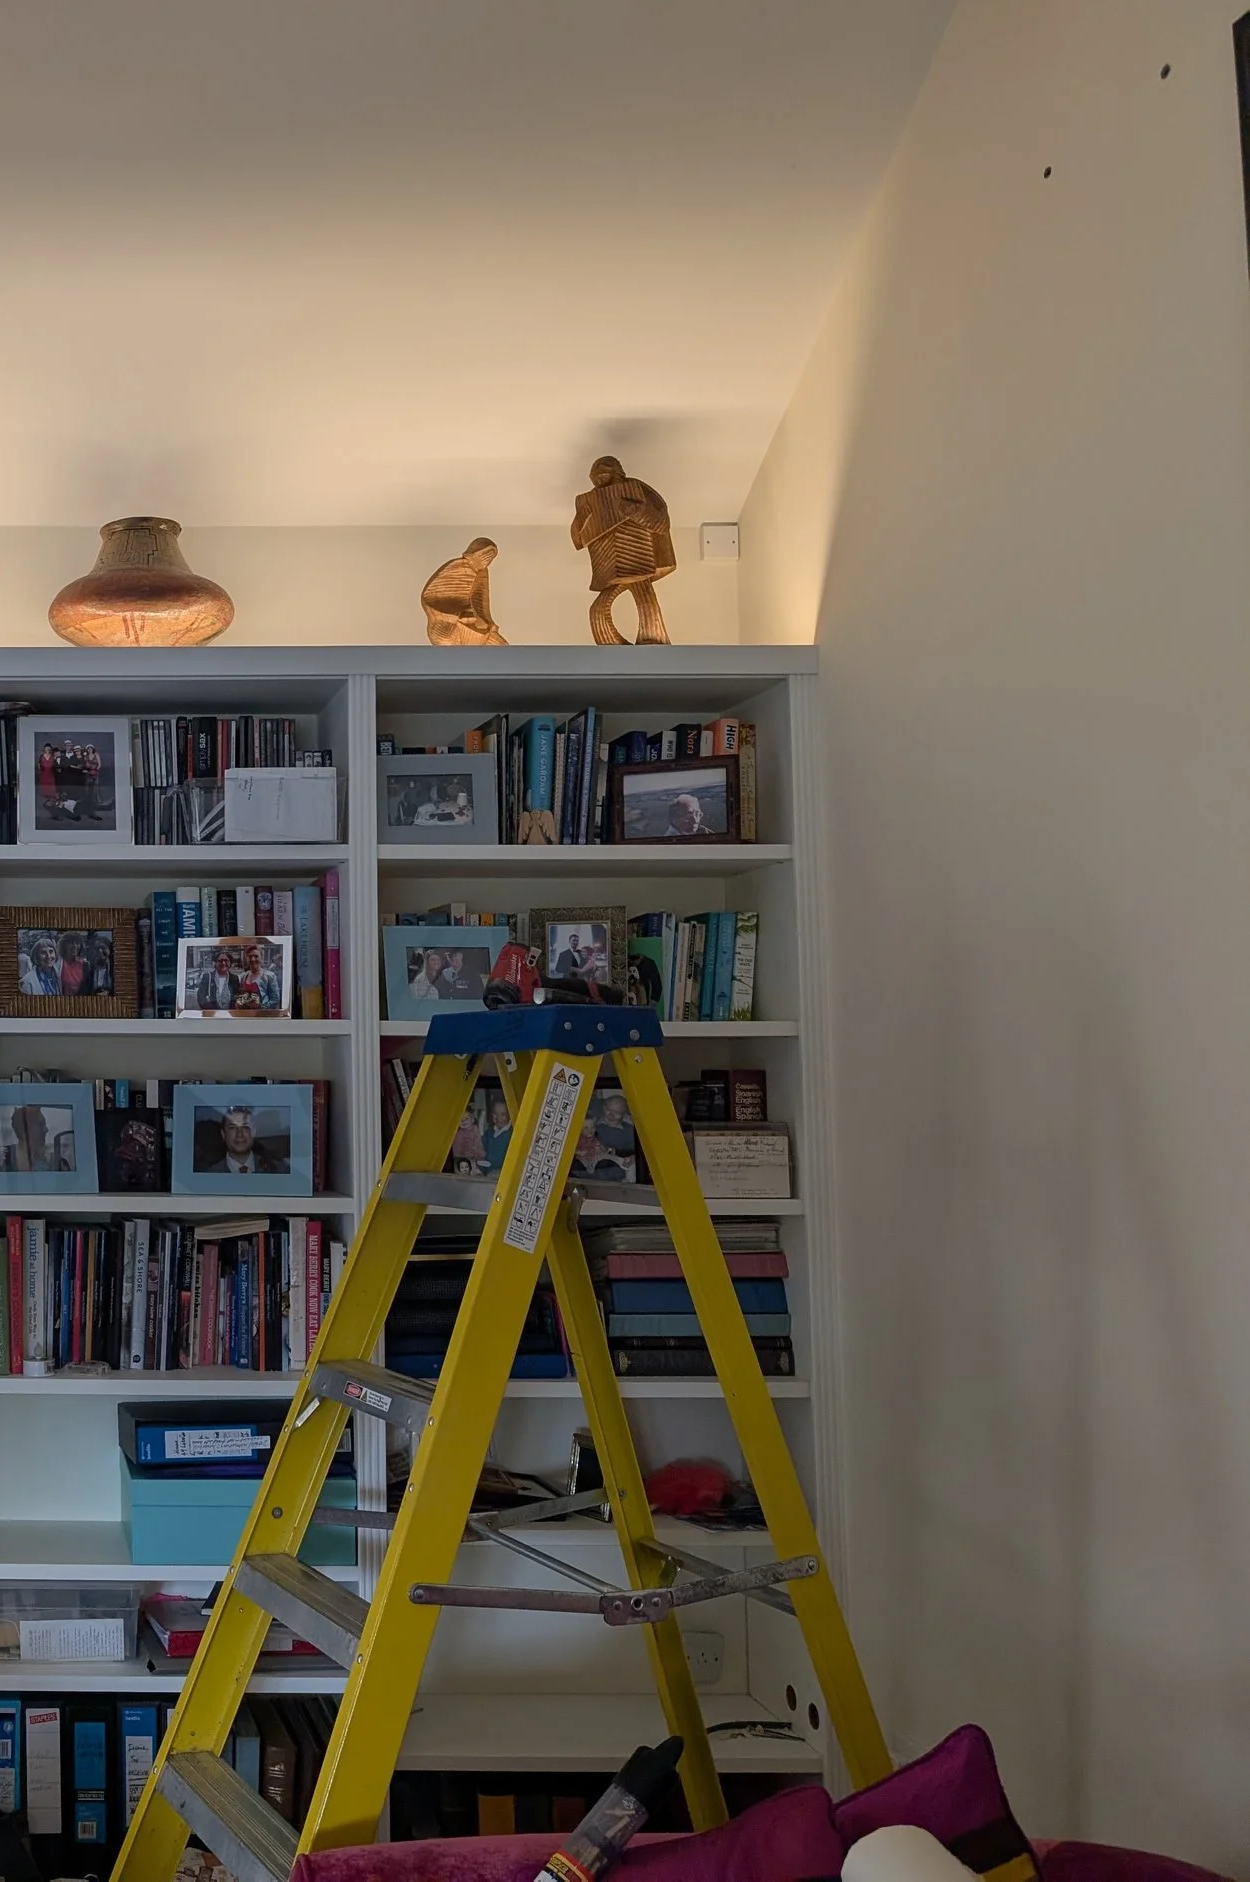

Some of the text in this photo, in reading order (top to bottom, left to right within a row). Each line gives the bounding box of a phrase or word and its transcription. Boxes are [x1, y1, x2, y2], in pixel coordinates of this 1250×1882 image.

[687, 730, 698, 754] Nora
[726, 725, 737, 750] HIGH
[539, 734, 549, 794] JANE GARDAM
[183, 909, 196, 938] AMI
[505, 953, 519, 984] Milwaukee
[735, 1090, 763, 1098] Spanish
[735, 1097, 761, 1105] English
[735, 1113, 763, 1121] Spanish
[27, 1226, 40, 1261] jamie
[309, 1235, 318, 1255] MARY
[240, 1264, 248, 1281] Mary
[309, 1256, 318, 1278] BERRY
[29, 1270, 38, 1298] home
[240, 1281, 248, 1304] Berry's
[309, 1280, 318, 1296] COOK
[309, 1298, 318, 1314] NOW
[309, 1315, 318, 1330] EAT
[31, 1713, 57, 1724] STAPLES
